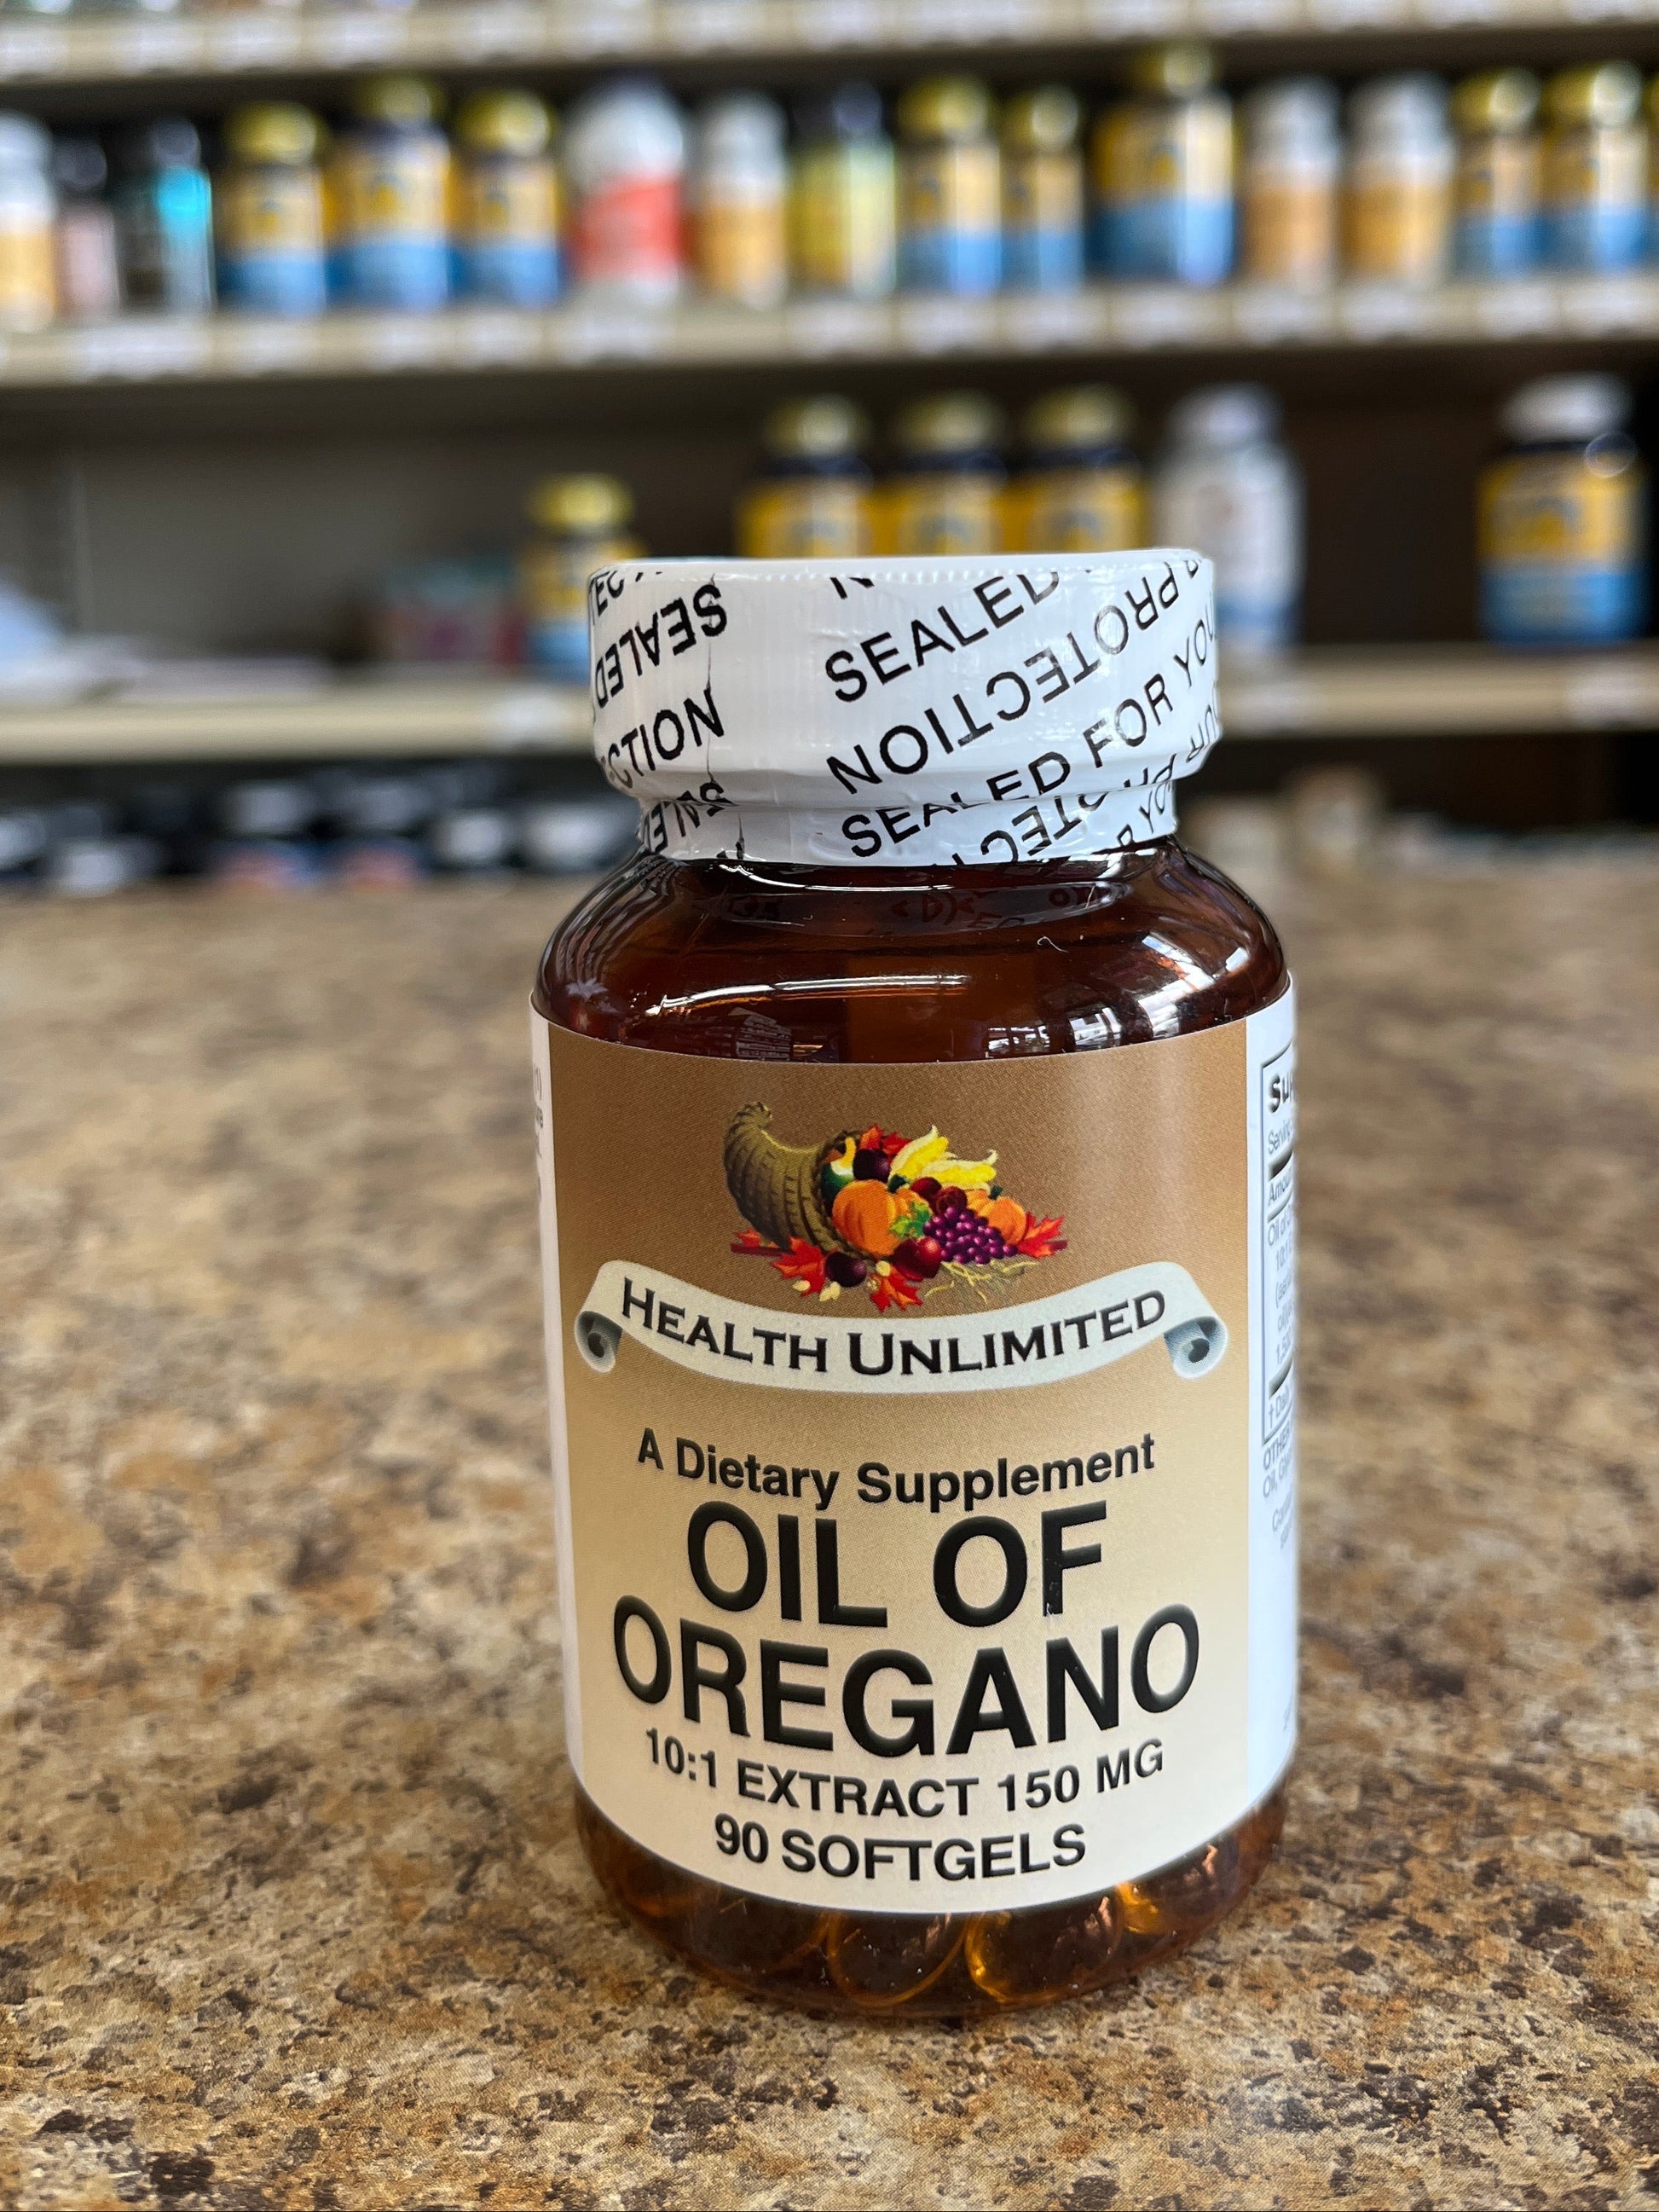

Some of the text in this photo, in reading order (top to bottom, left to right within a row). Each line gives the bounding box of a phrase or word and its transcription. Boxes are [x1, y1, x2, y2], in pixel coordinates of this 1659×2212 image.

[596, 584, 727, 709] SEALED
[825, 571, 1060, 703] SEALED
[826, 561, 1179, 795] PROTECTION
[1083, 673, 1173, 767] FOR
[622, 1277, 1166, 1375] HEALTH UNLIMITED
[636, 1427, 1155, 1514] A Dietary Supplement
[687, 1501, 1107, 1628] OIL OF
[613, 1595, 1199, 1758] OREGANO
[645, 1728, 1164, 1818] 10:1 EXTRACT 150 MG
[714, 1813, 1086, 1881] 90 SOFTGELS
